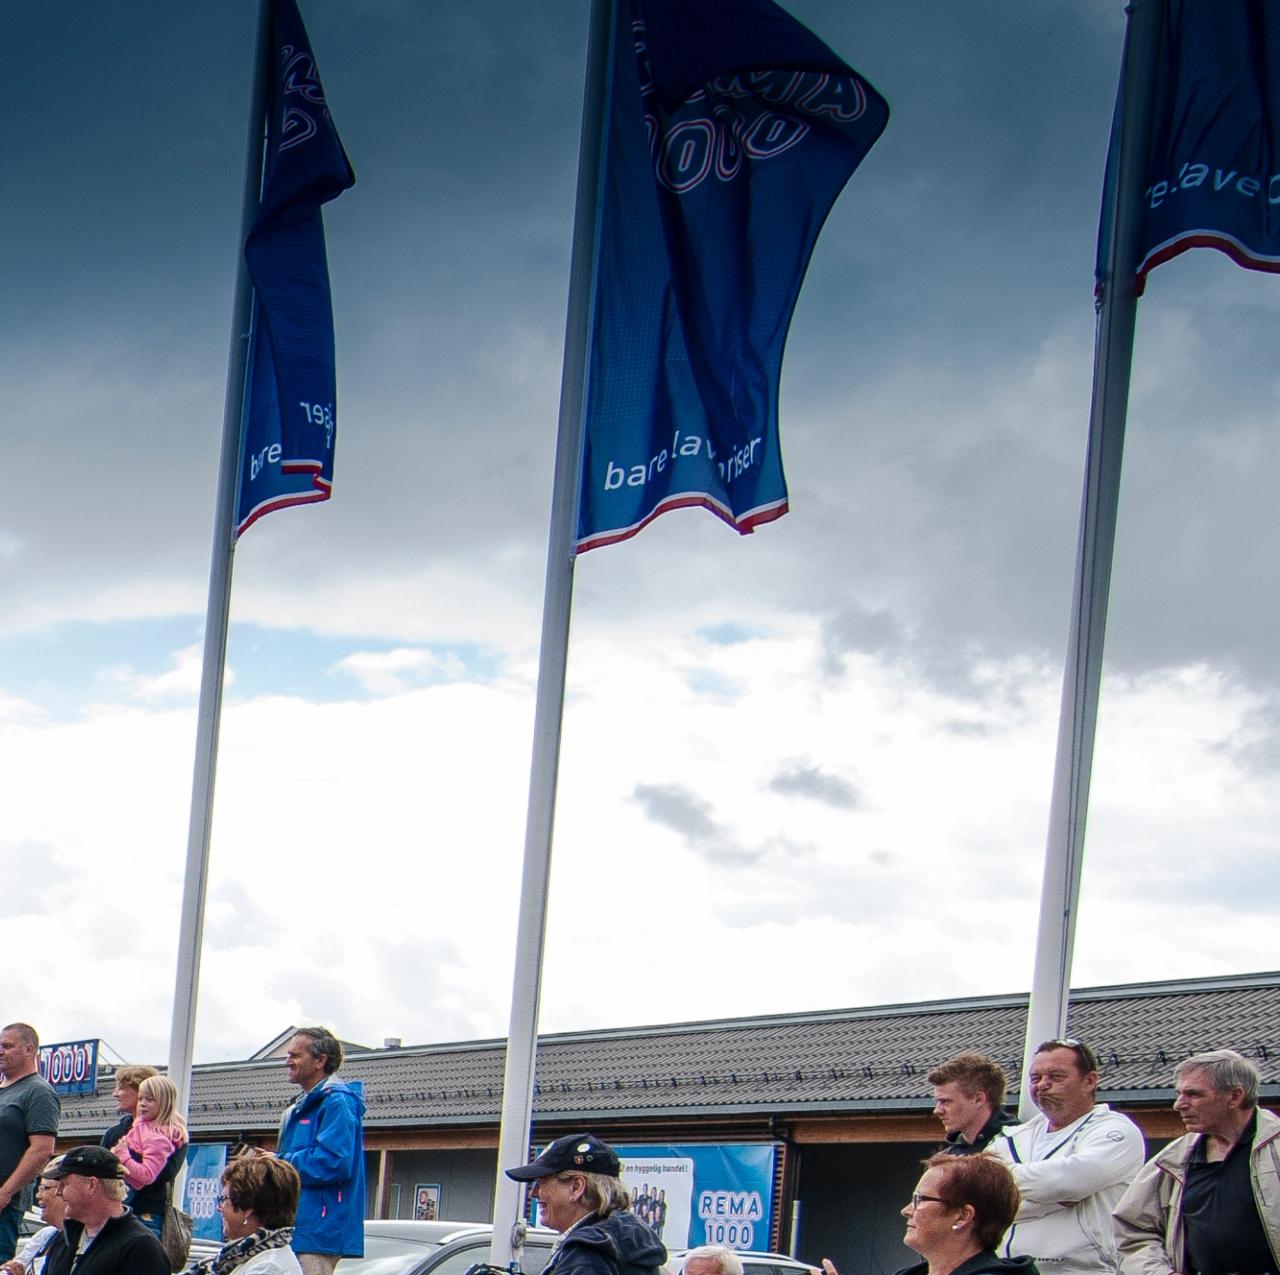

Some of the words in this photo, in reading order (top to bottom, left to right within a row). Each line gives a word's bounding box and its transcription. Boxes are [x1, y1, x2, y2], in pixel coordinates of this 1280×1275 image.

[604, 449, 668, 491] bare
[635, 1163, 662, 1175] hyggelig
[189, 1181, 218, 1196] REMA
[191, 1200, 215, 1217] 1000
[700, 1193, 761, 1218] REMA
[706, 1223, 753, 1247] 1000
